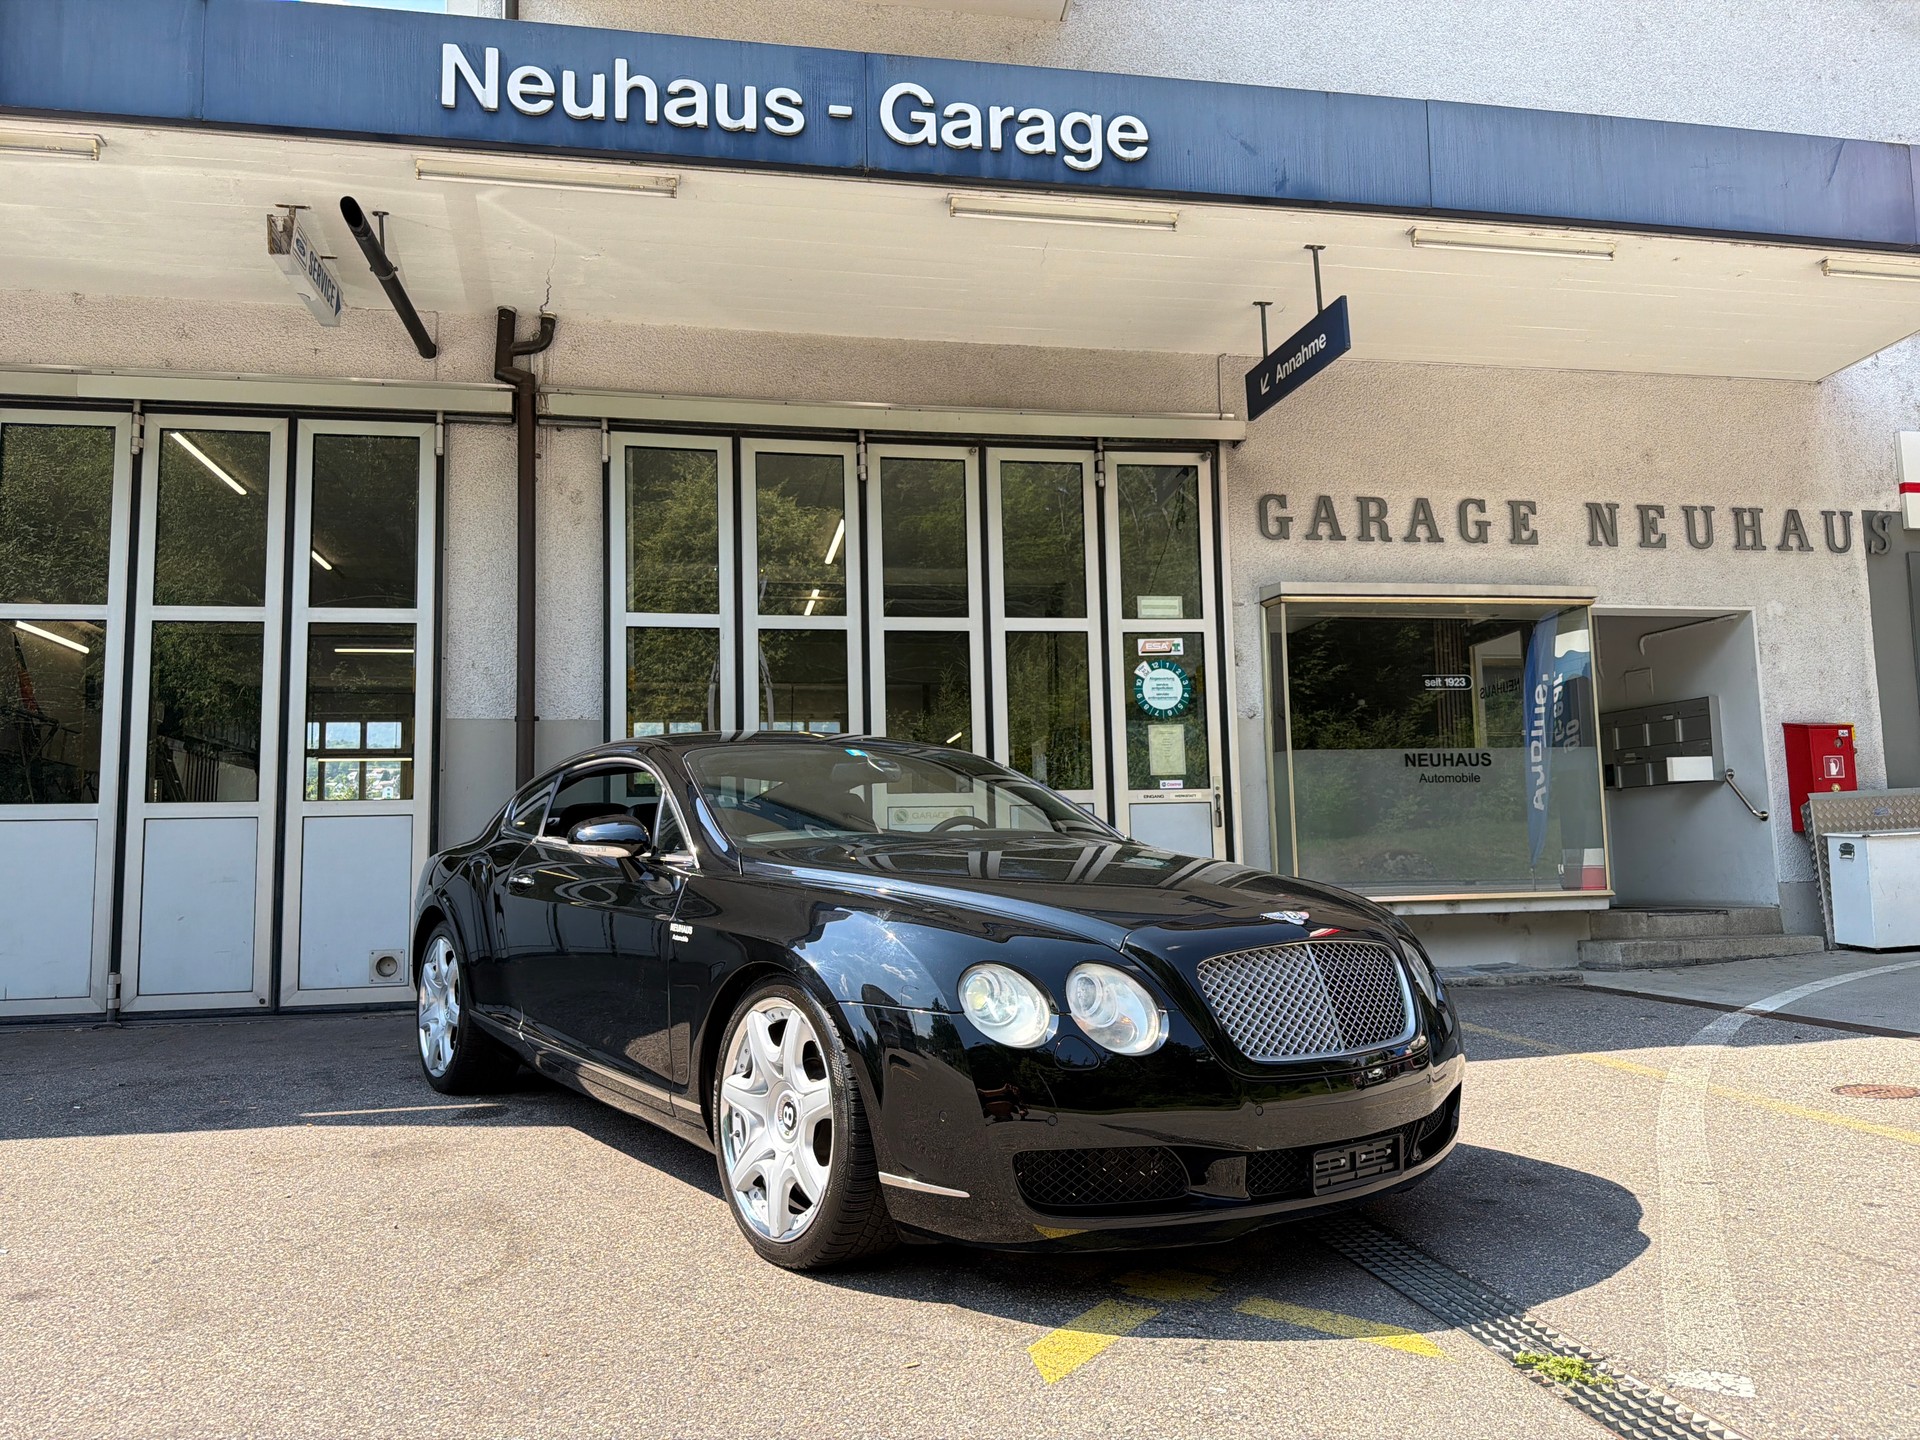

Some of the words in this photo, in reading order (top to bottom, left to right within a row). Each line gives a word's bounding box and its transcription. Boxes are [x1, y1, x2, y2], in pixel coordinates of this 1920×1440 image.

[440, 42, 804, 138] Neuhaus
[879, 82, 1149, 171] Garage
[308, 250, 336, 309] SERVICE
[1275, 333, 1327, 385] Annahme
[1258, 494, 1539, 545] GARAGE
[1585, 502, 1893, 555] NEUHAUS
[1424, 677, 1442, 687] seit
[1444, 677, 1466, 687] 1923
[1404, 752, 1492, 767] NEUHAUS
[1418, 772, 1481, 783] Automobile
